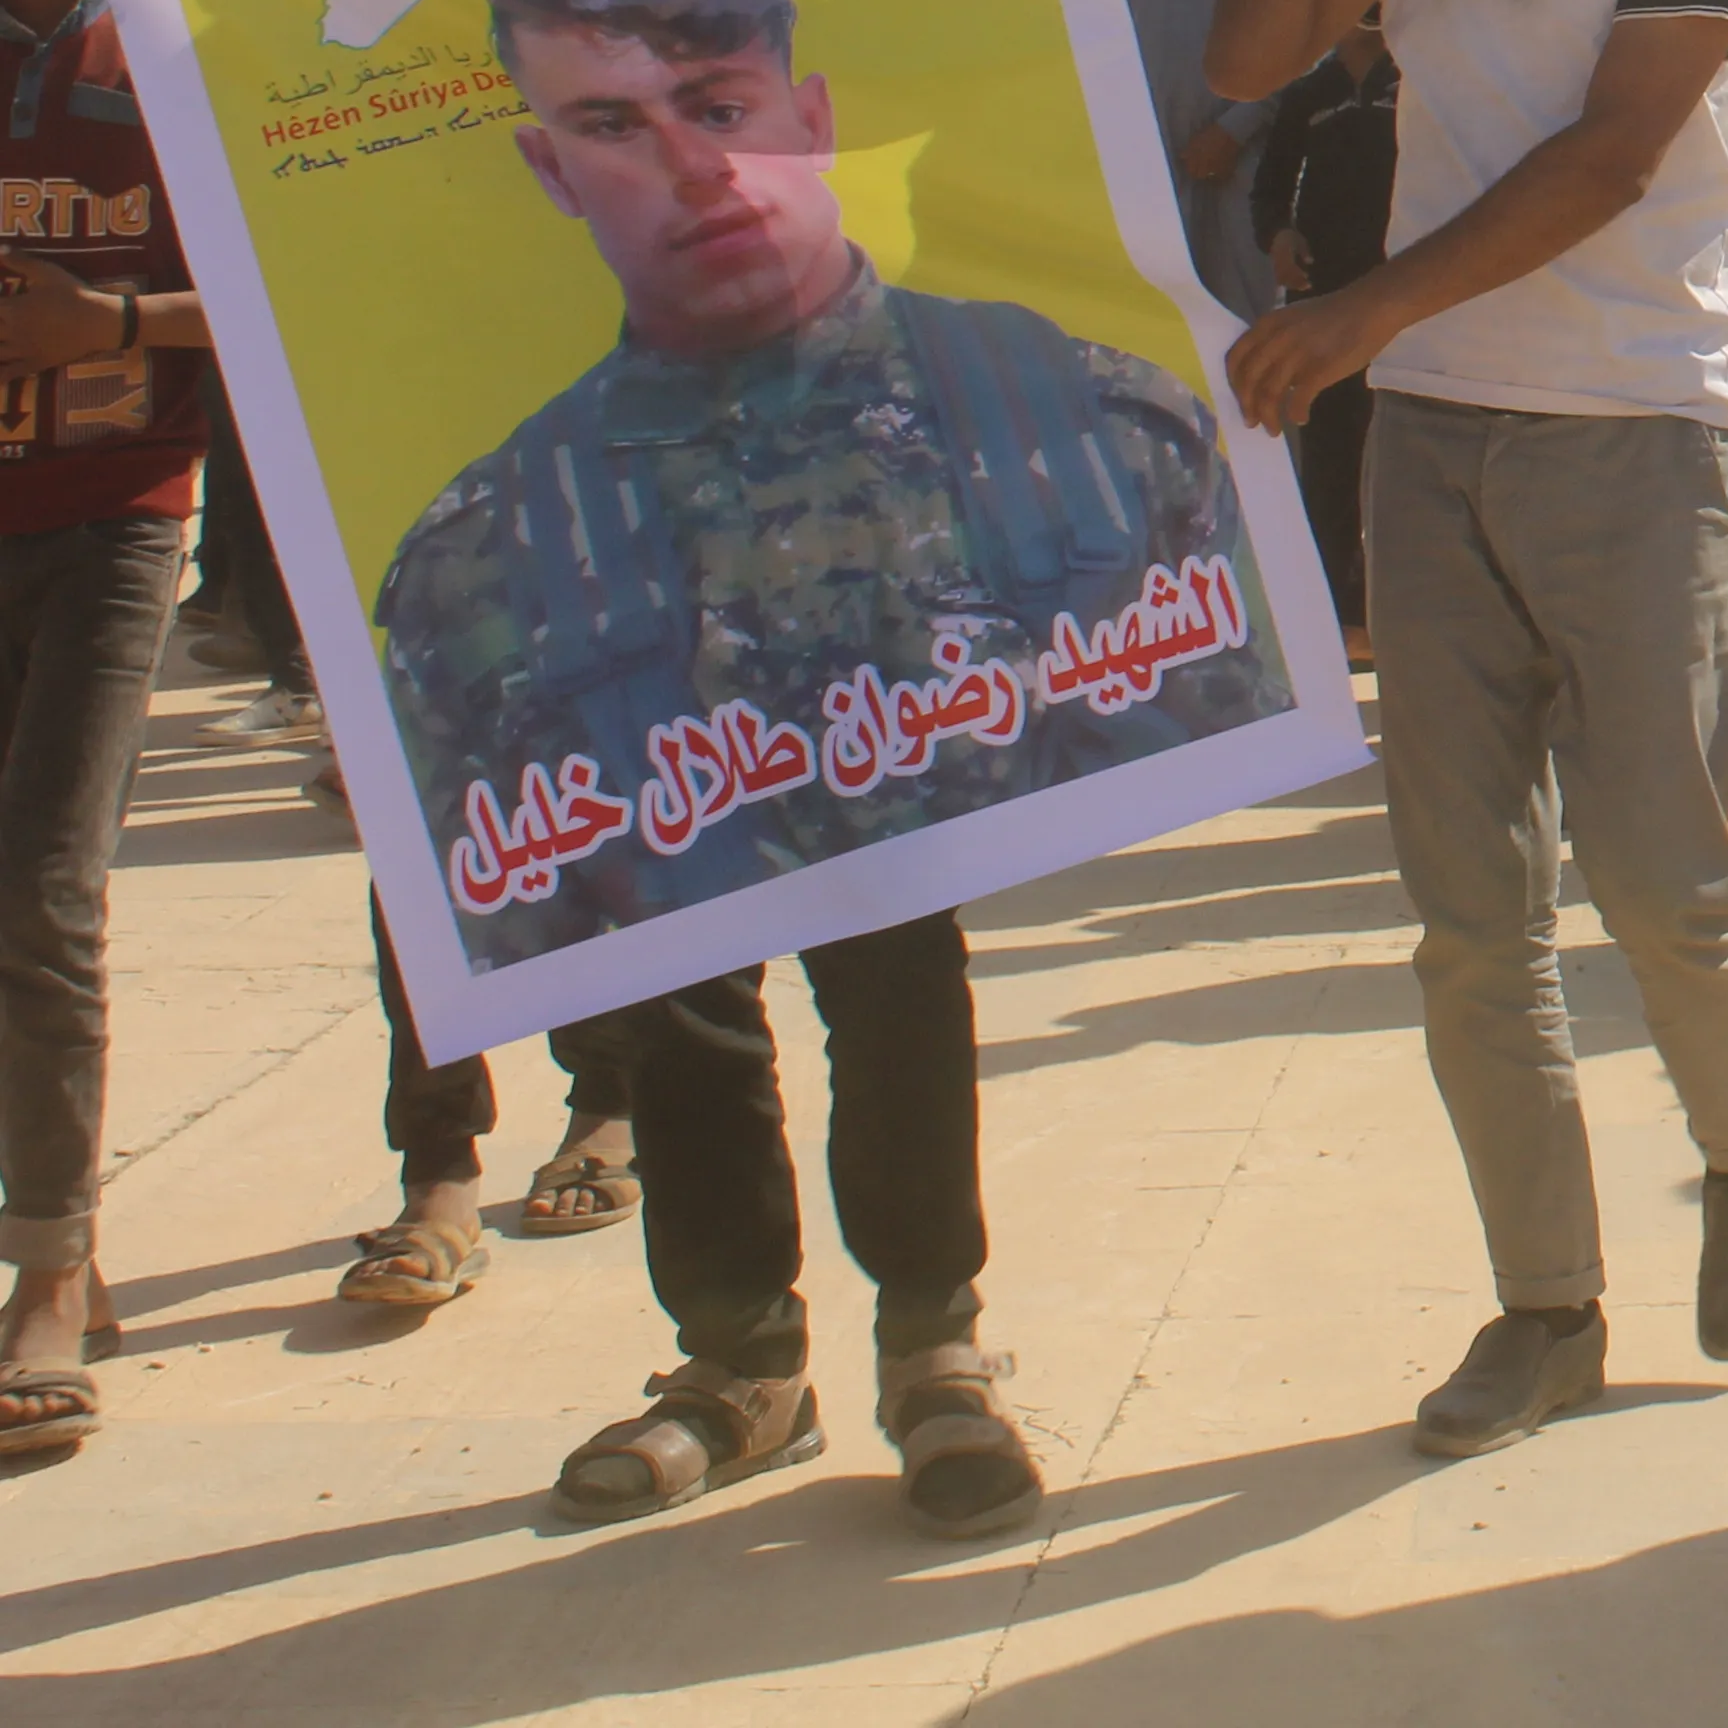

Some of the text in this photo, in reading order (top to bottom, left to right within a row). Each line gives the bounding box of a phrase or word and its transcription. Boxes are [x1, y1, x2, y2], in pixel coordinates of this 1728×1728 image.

[261, 102, 362, 147] Hêzên
[368, 77, 468, 119] Sûriya
[450, 556, 1247, 914] الشهيد رضوان طلال خليل
